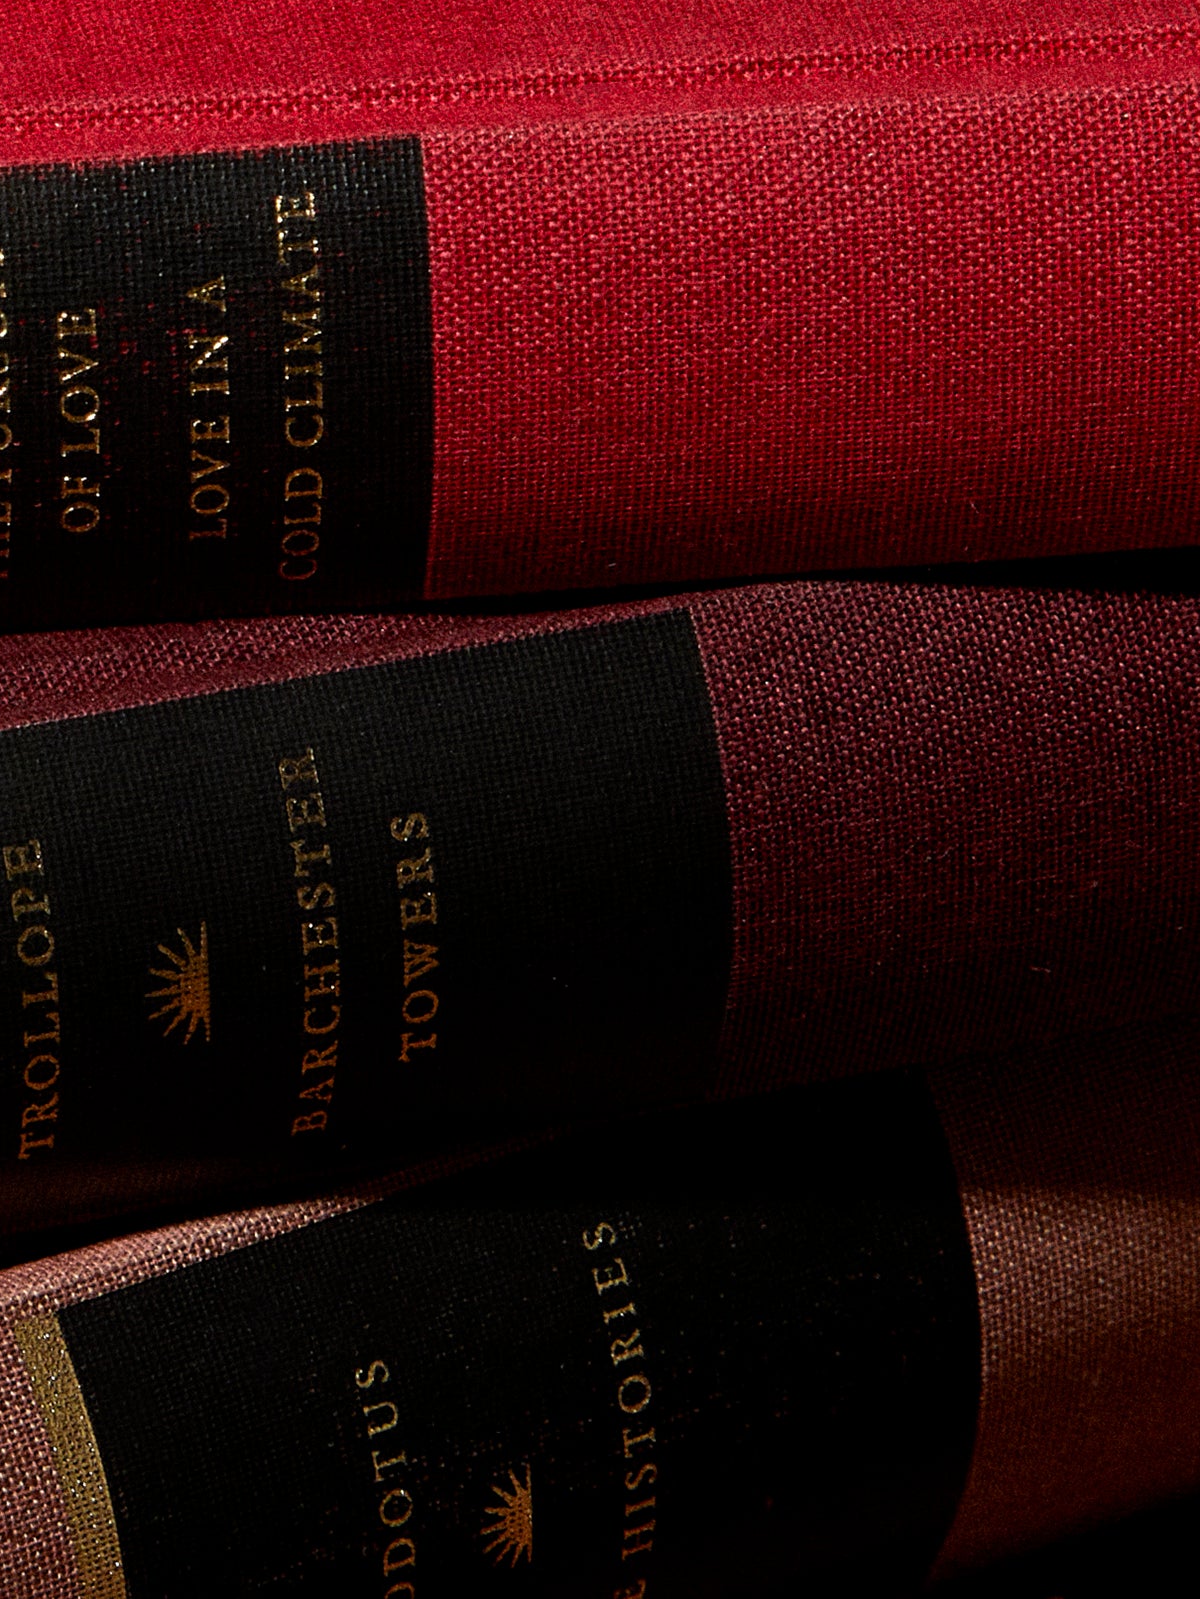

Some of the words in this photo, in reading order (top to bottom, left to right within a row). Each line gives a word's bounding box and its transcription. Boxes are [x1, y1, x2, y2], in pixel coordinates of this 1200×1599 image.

[186, 274, 227, 313] A
[188, 333, 230, 396] IN
[275, 190, 324, 448] CLIMATE
[57, 307, 102, 456] LOVE
[60, 475, 102, 535] OF
[189, 415, 231, 541] LOVE
[280, 467, 324, 581] COLD
[2, 839, 61, 1160] TROLLOPE
[278, 747, 341, 1136] BARCHESTER
[390, 812, 440, 1063] TOWERS
[582, 1222, 658, 1561] HISTORIES
